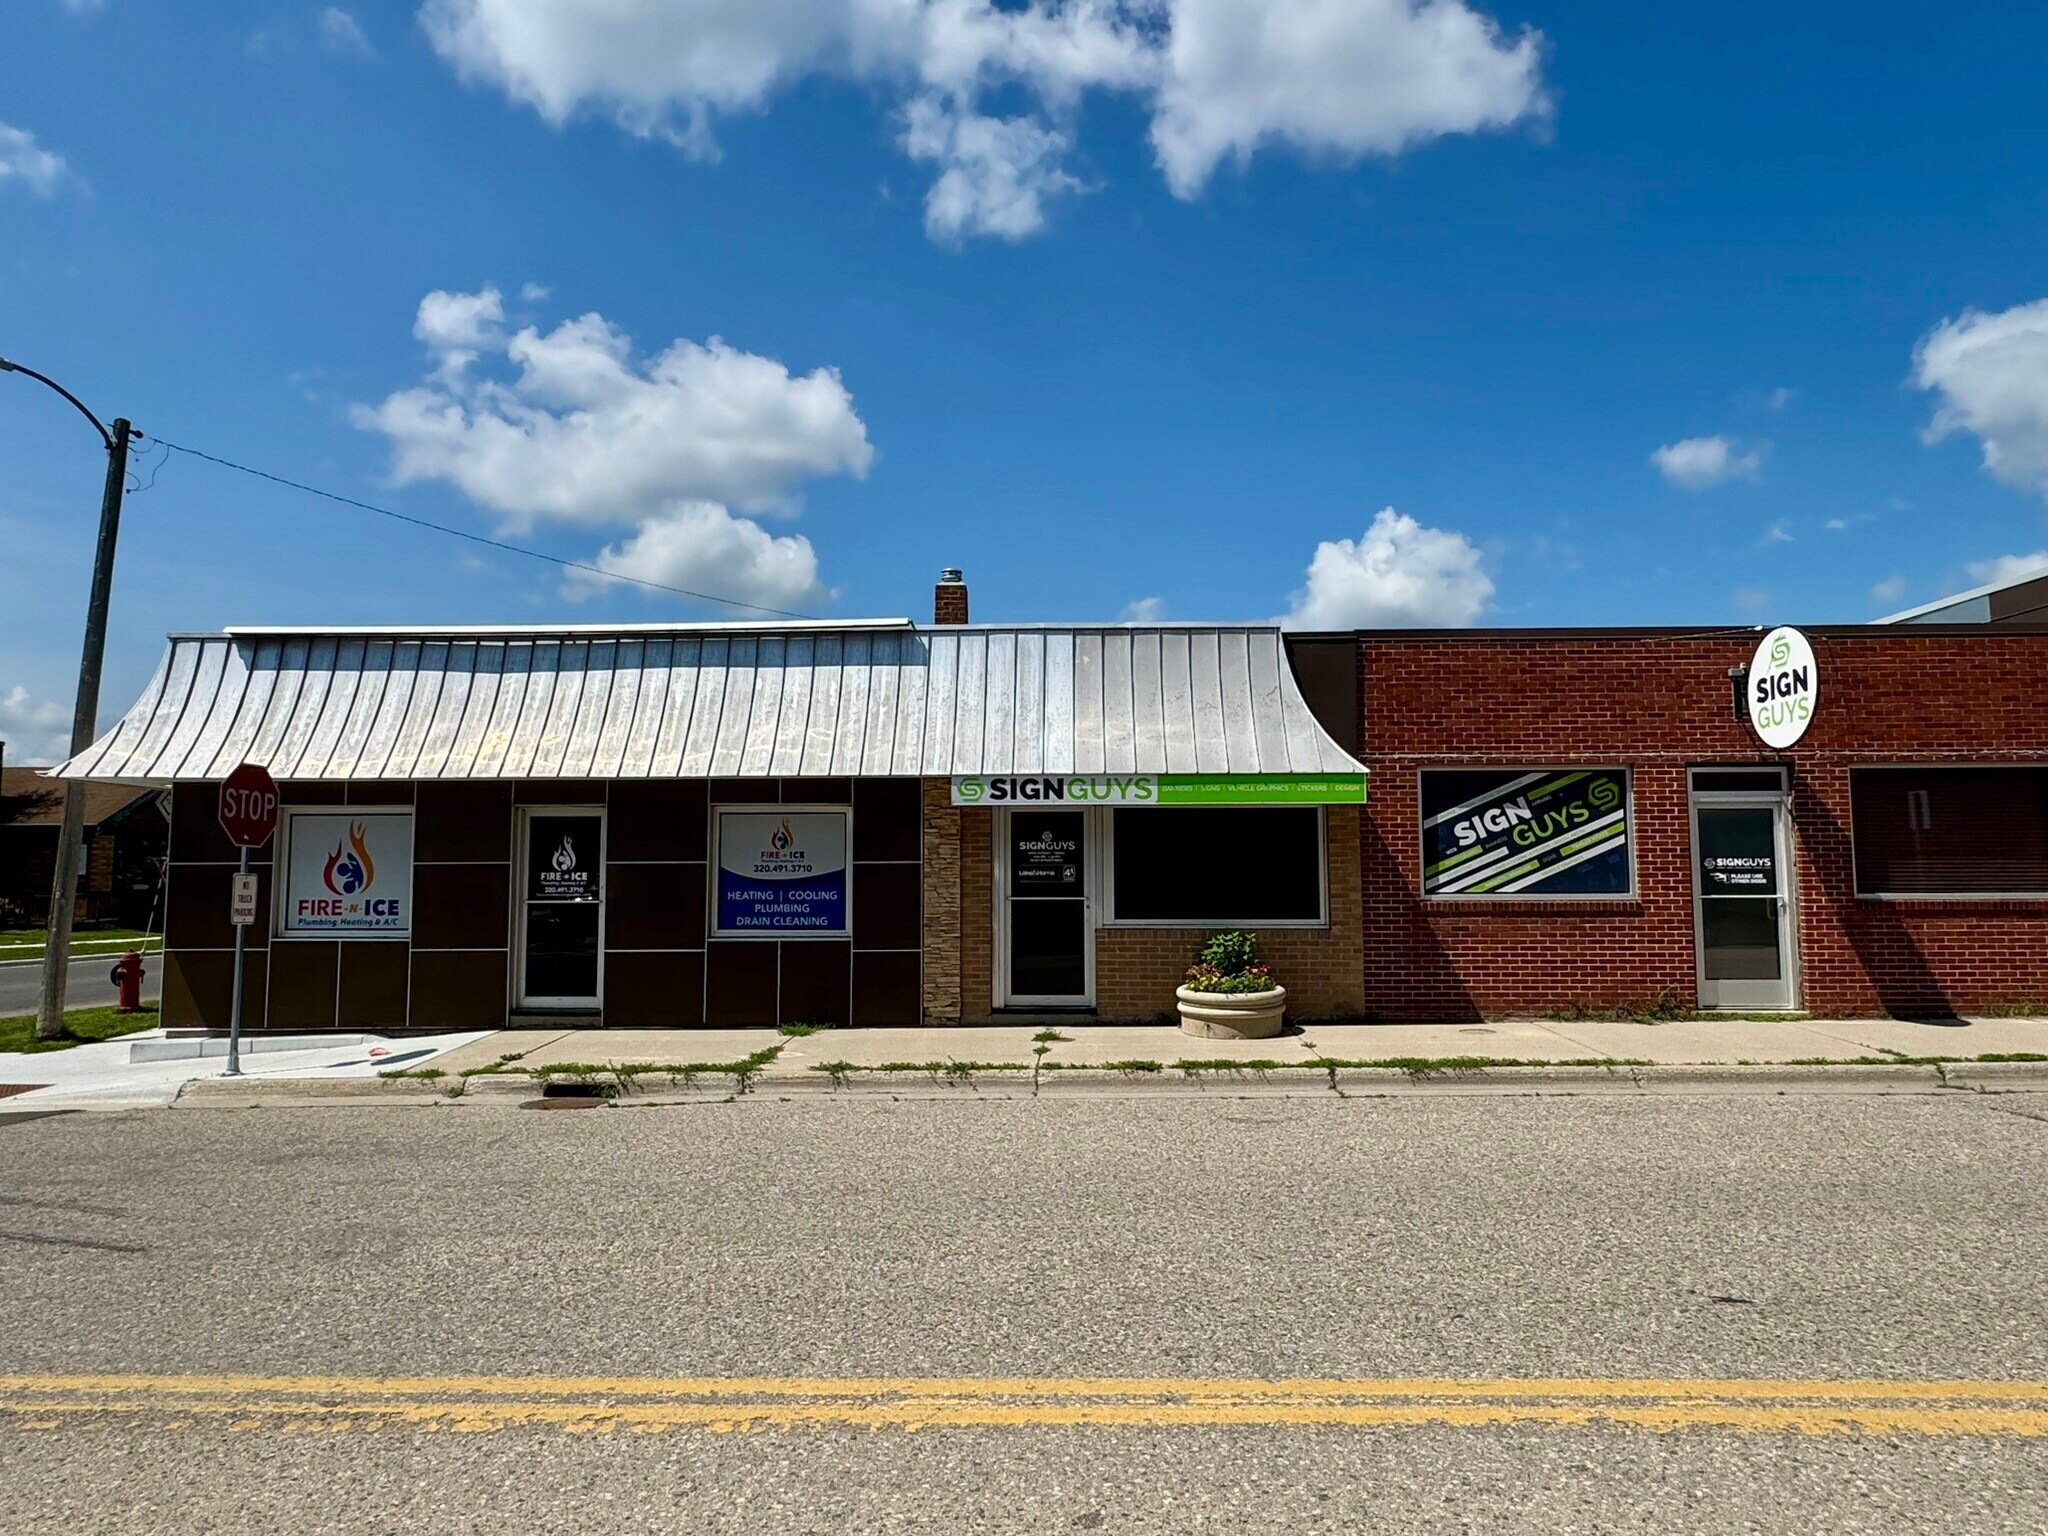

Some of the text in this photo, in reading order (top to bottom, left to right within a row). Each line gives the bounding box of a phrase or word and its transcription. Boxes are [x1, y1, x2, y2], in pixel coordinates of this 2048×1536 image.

[1757, 665, 1808, 703] SIGN
[1758, 697, 1809, 728] GUYS
[989, 777, 1153, 800] SIGNGUYS
[224, 788, 275, 821] STOP
[1454, 796, 1533, 847] SIGN
[1513, 800, 1590, 846] GUYS
[1020, 841, 1075, 850] SIGNGUYS
[760, 851, 780, 859] FIRE
[789, 851, 805, 859] ICE
[1716, 857, 1772, 867] SIGNGUYS
[753, 864, 813, 873] 320.491.3710
[540, 872, 562, 881] FIRE
[571, 872, 588, 881] ICE
[727, 891, 838, 900] HEATING COOLING
[298, 899, 343, 917] FIRE
[364, 899, 399, 917] ICE
[754, 904, 810, 913] PLUMBING
[297, 917, 337, 927] Plumbing
[340, 917, 373, 928] Heating
[383, 917, 399, 926] A/C
[736, 917, 828, 926] DRAIN CLEANING
